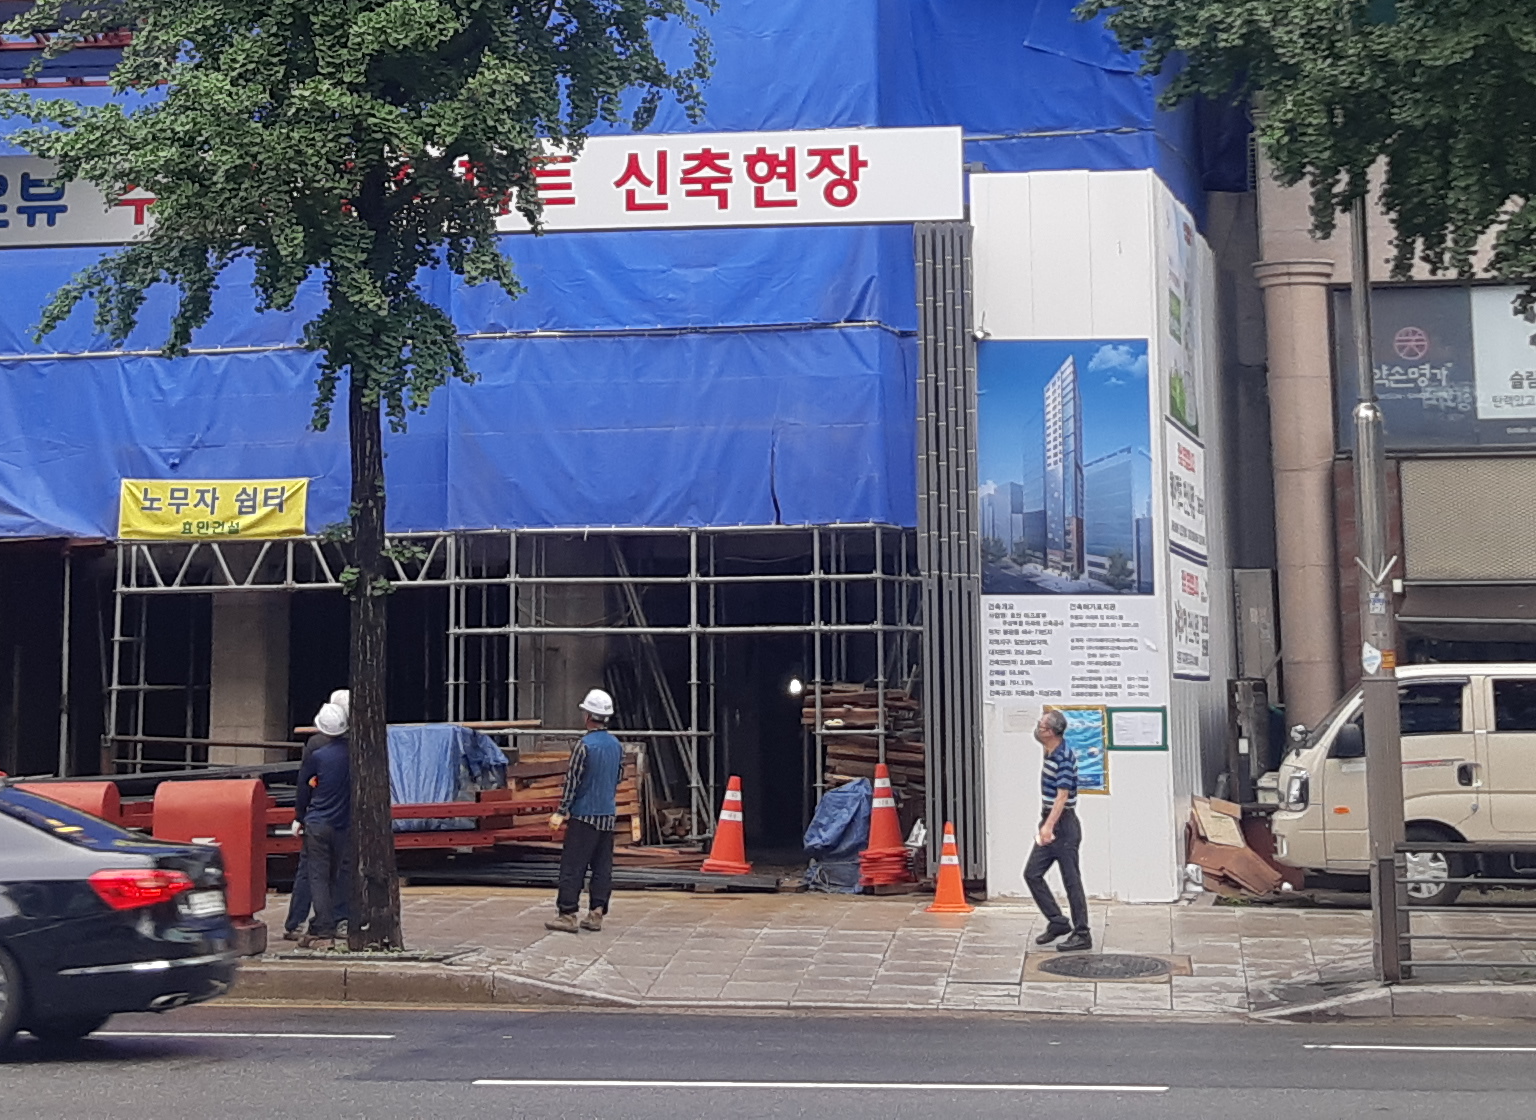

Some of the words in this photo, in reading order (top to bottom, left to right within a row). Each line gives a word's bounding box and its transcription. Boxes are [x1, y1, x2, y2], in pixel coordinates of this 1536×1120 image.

[613, 143, 869, 214] 신축현장
[140, 486, 220, 516] 노무자
[235, 486, 287, 515] 쉼터
